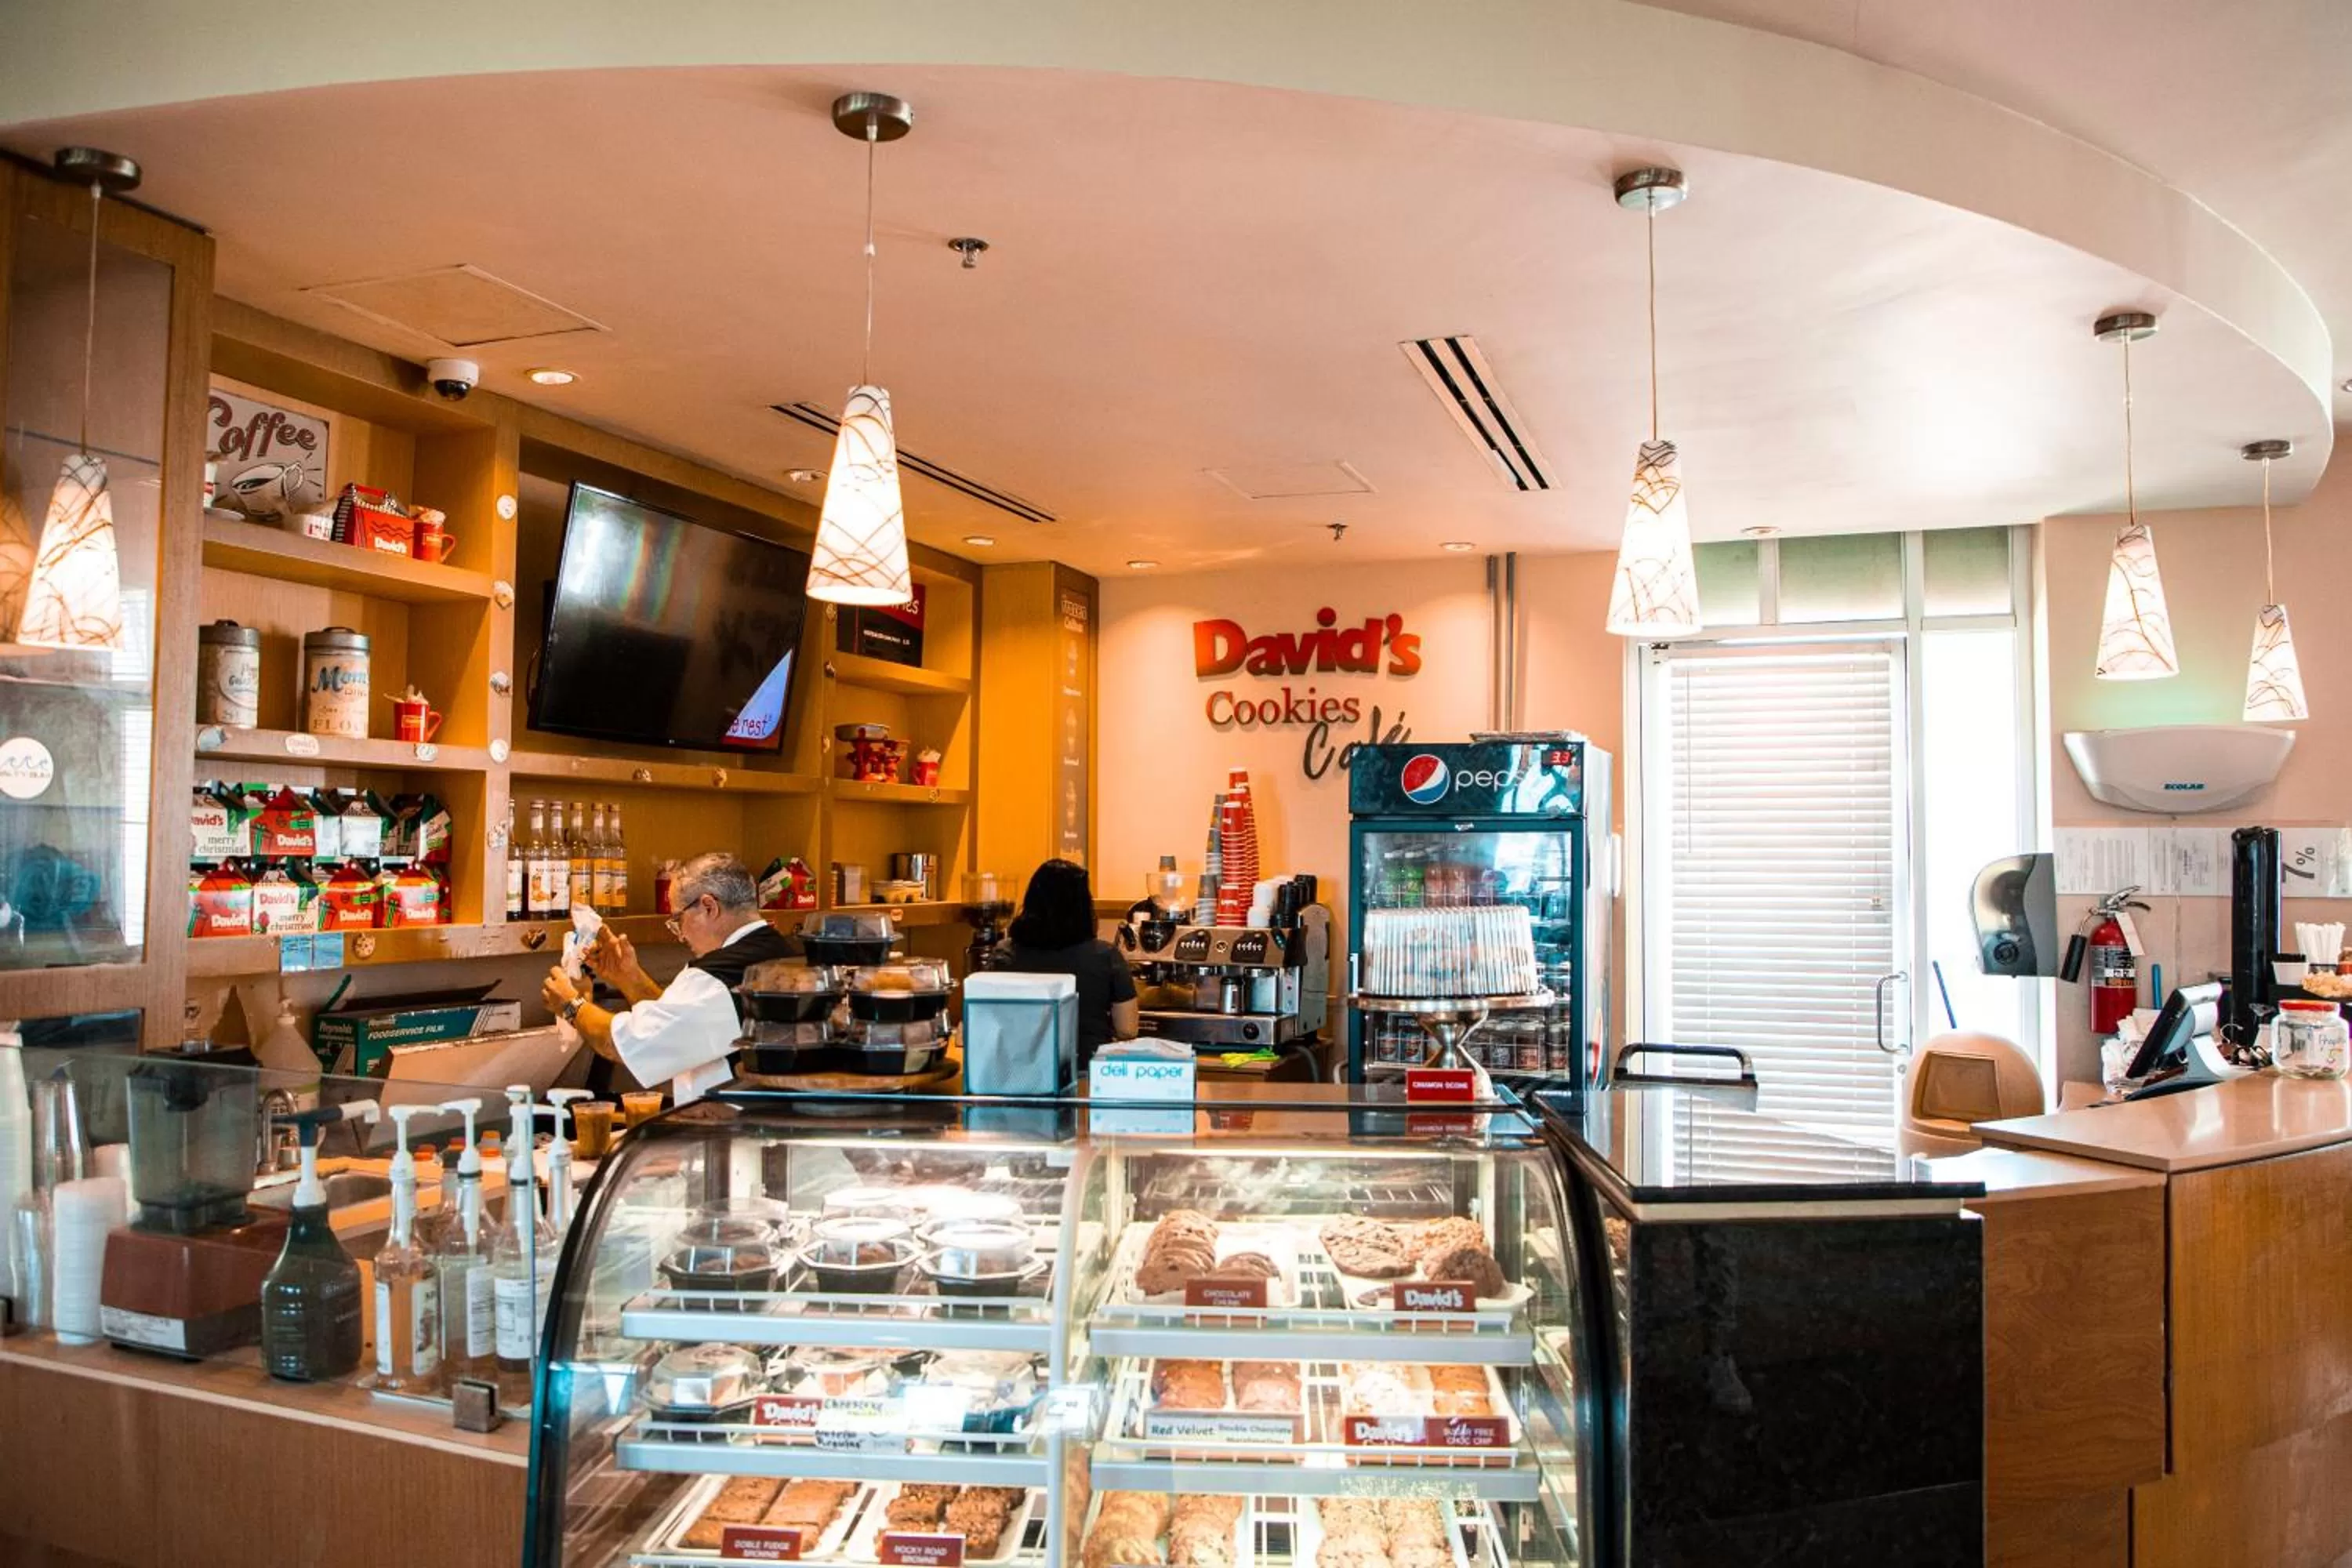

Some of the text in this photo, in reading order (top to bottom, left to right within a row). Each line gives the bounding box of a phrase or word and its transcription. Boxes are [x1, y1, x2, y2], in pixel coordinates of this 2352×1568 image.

[1192, 607, 1422, 677] David's
[1206, 688, 1360, 725] Cookies
[1455, 770, 1526, 793] peps
[191, 813, 224, 826] avid's
[1100, 1060, 1184, 1080] deli paper
[1405, 1287, 1464, 1308] David's
[1151, 1424, 1173, 1436] Red
